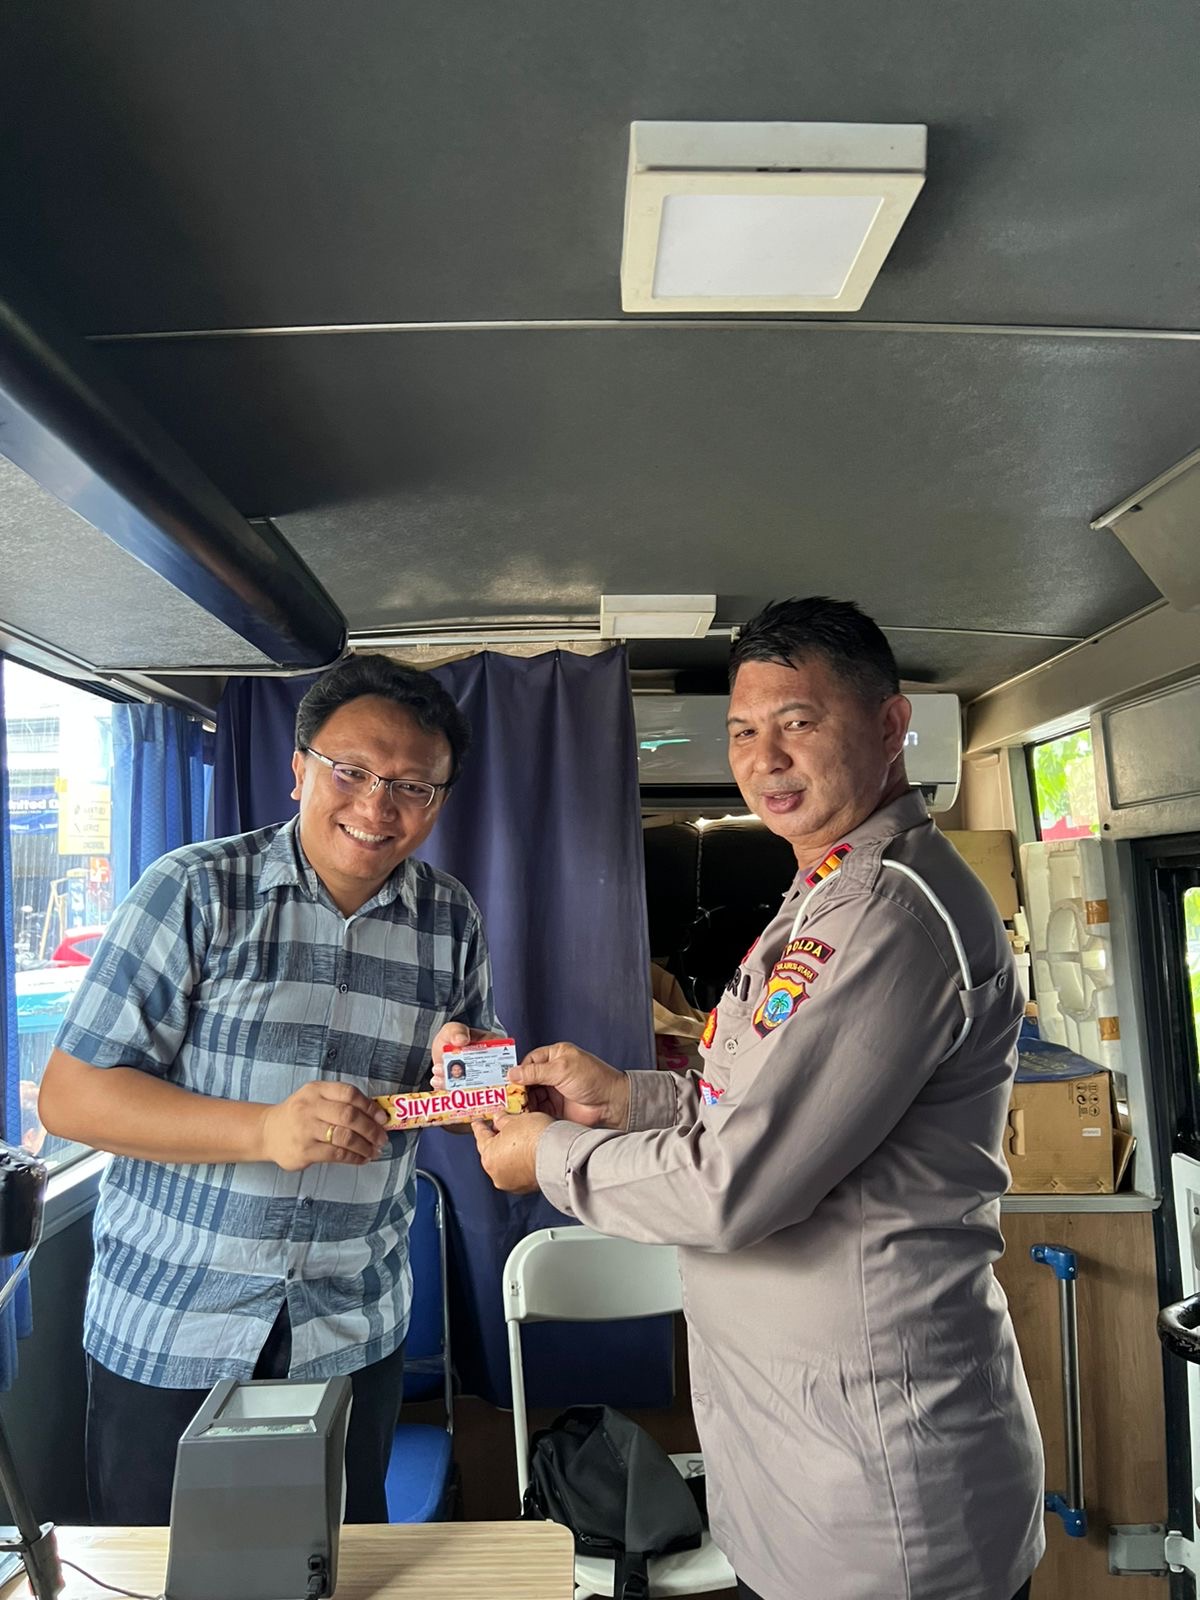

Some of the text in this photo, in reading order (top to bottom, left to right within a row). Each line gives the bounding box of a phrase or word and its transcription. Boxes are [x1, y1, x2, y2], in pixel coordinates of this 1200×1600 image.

[786, 939, 823, 958] POLDA
[725, 967, 751, 1002] RI
[395, 1088, 507, 1117] SILVERQUEEN
